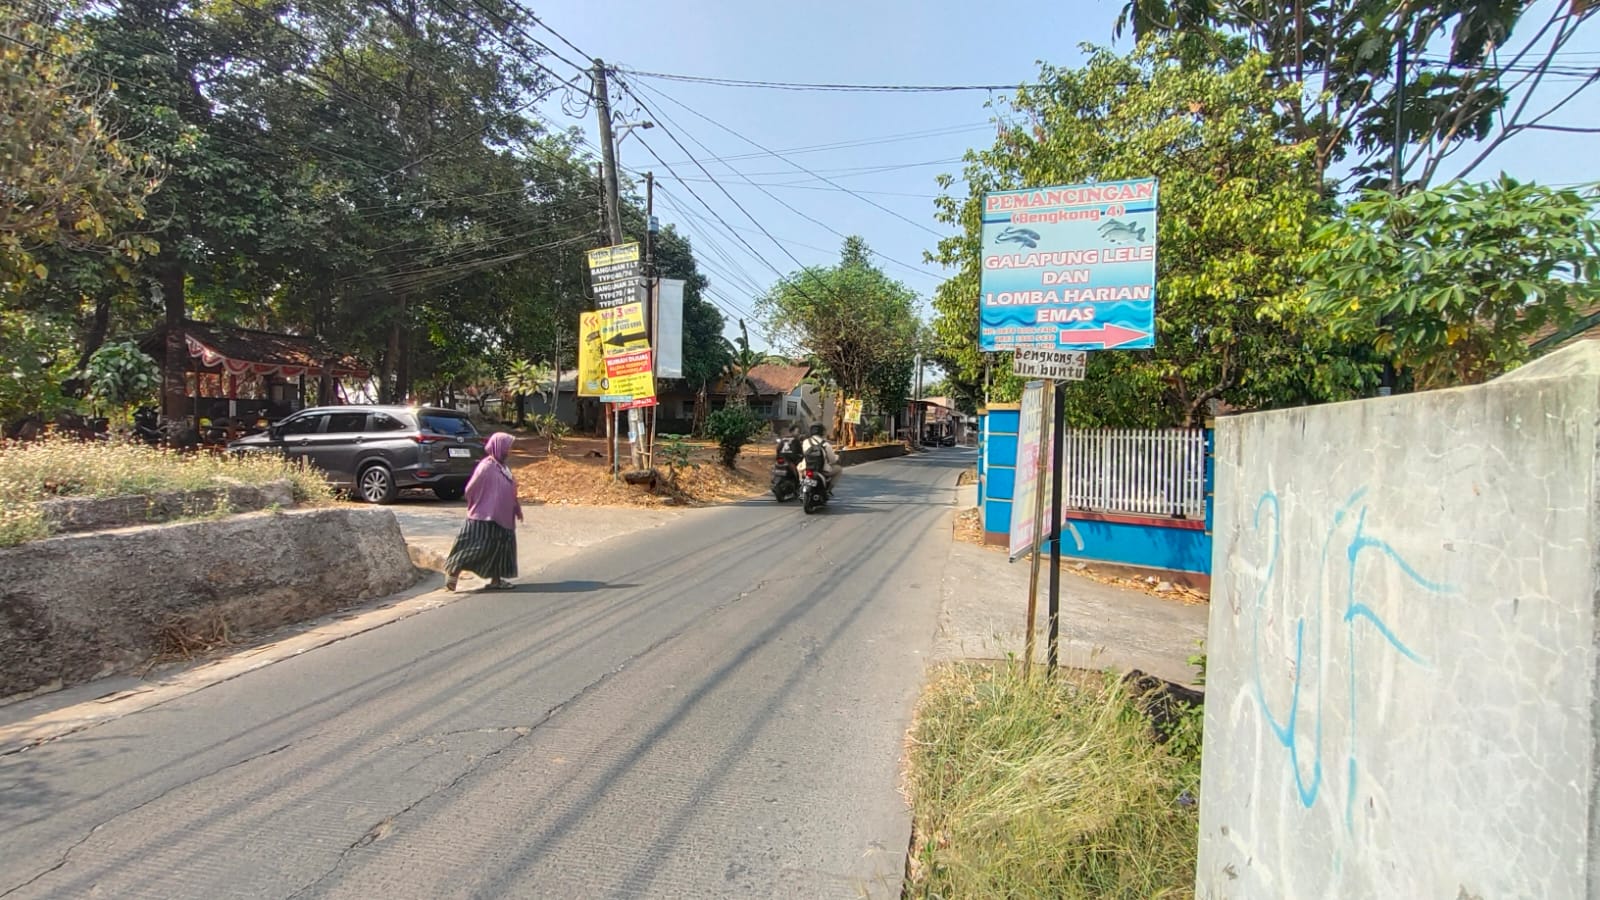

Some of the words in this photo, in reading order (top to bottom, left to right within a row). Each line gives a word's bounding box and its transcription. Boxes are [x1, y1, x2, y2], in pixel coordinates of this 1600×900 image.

[986, 183, 1153, 210] PEMANCINGAN
[985, 251, 1098, 269] GALAPUNG
[1103, 246, 1153, 263] LELE
[1042, 270, 1089, 285] DAN
[986, 289, 1059, 306] LOMBA
[1064, 286, 1150, 303] HARIAN
[616, 308, 623, 318] 3
[1036, 307, 1095, 323] EMAS
[1075, 353, 1085, 366] 4
